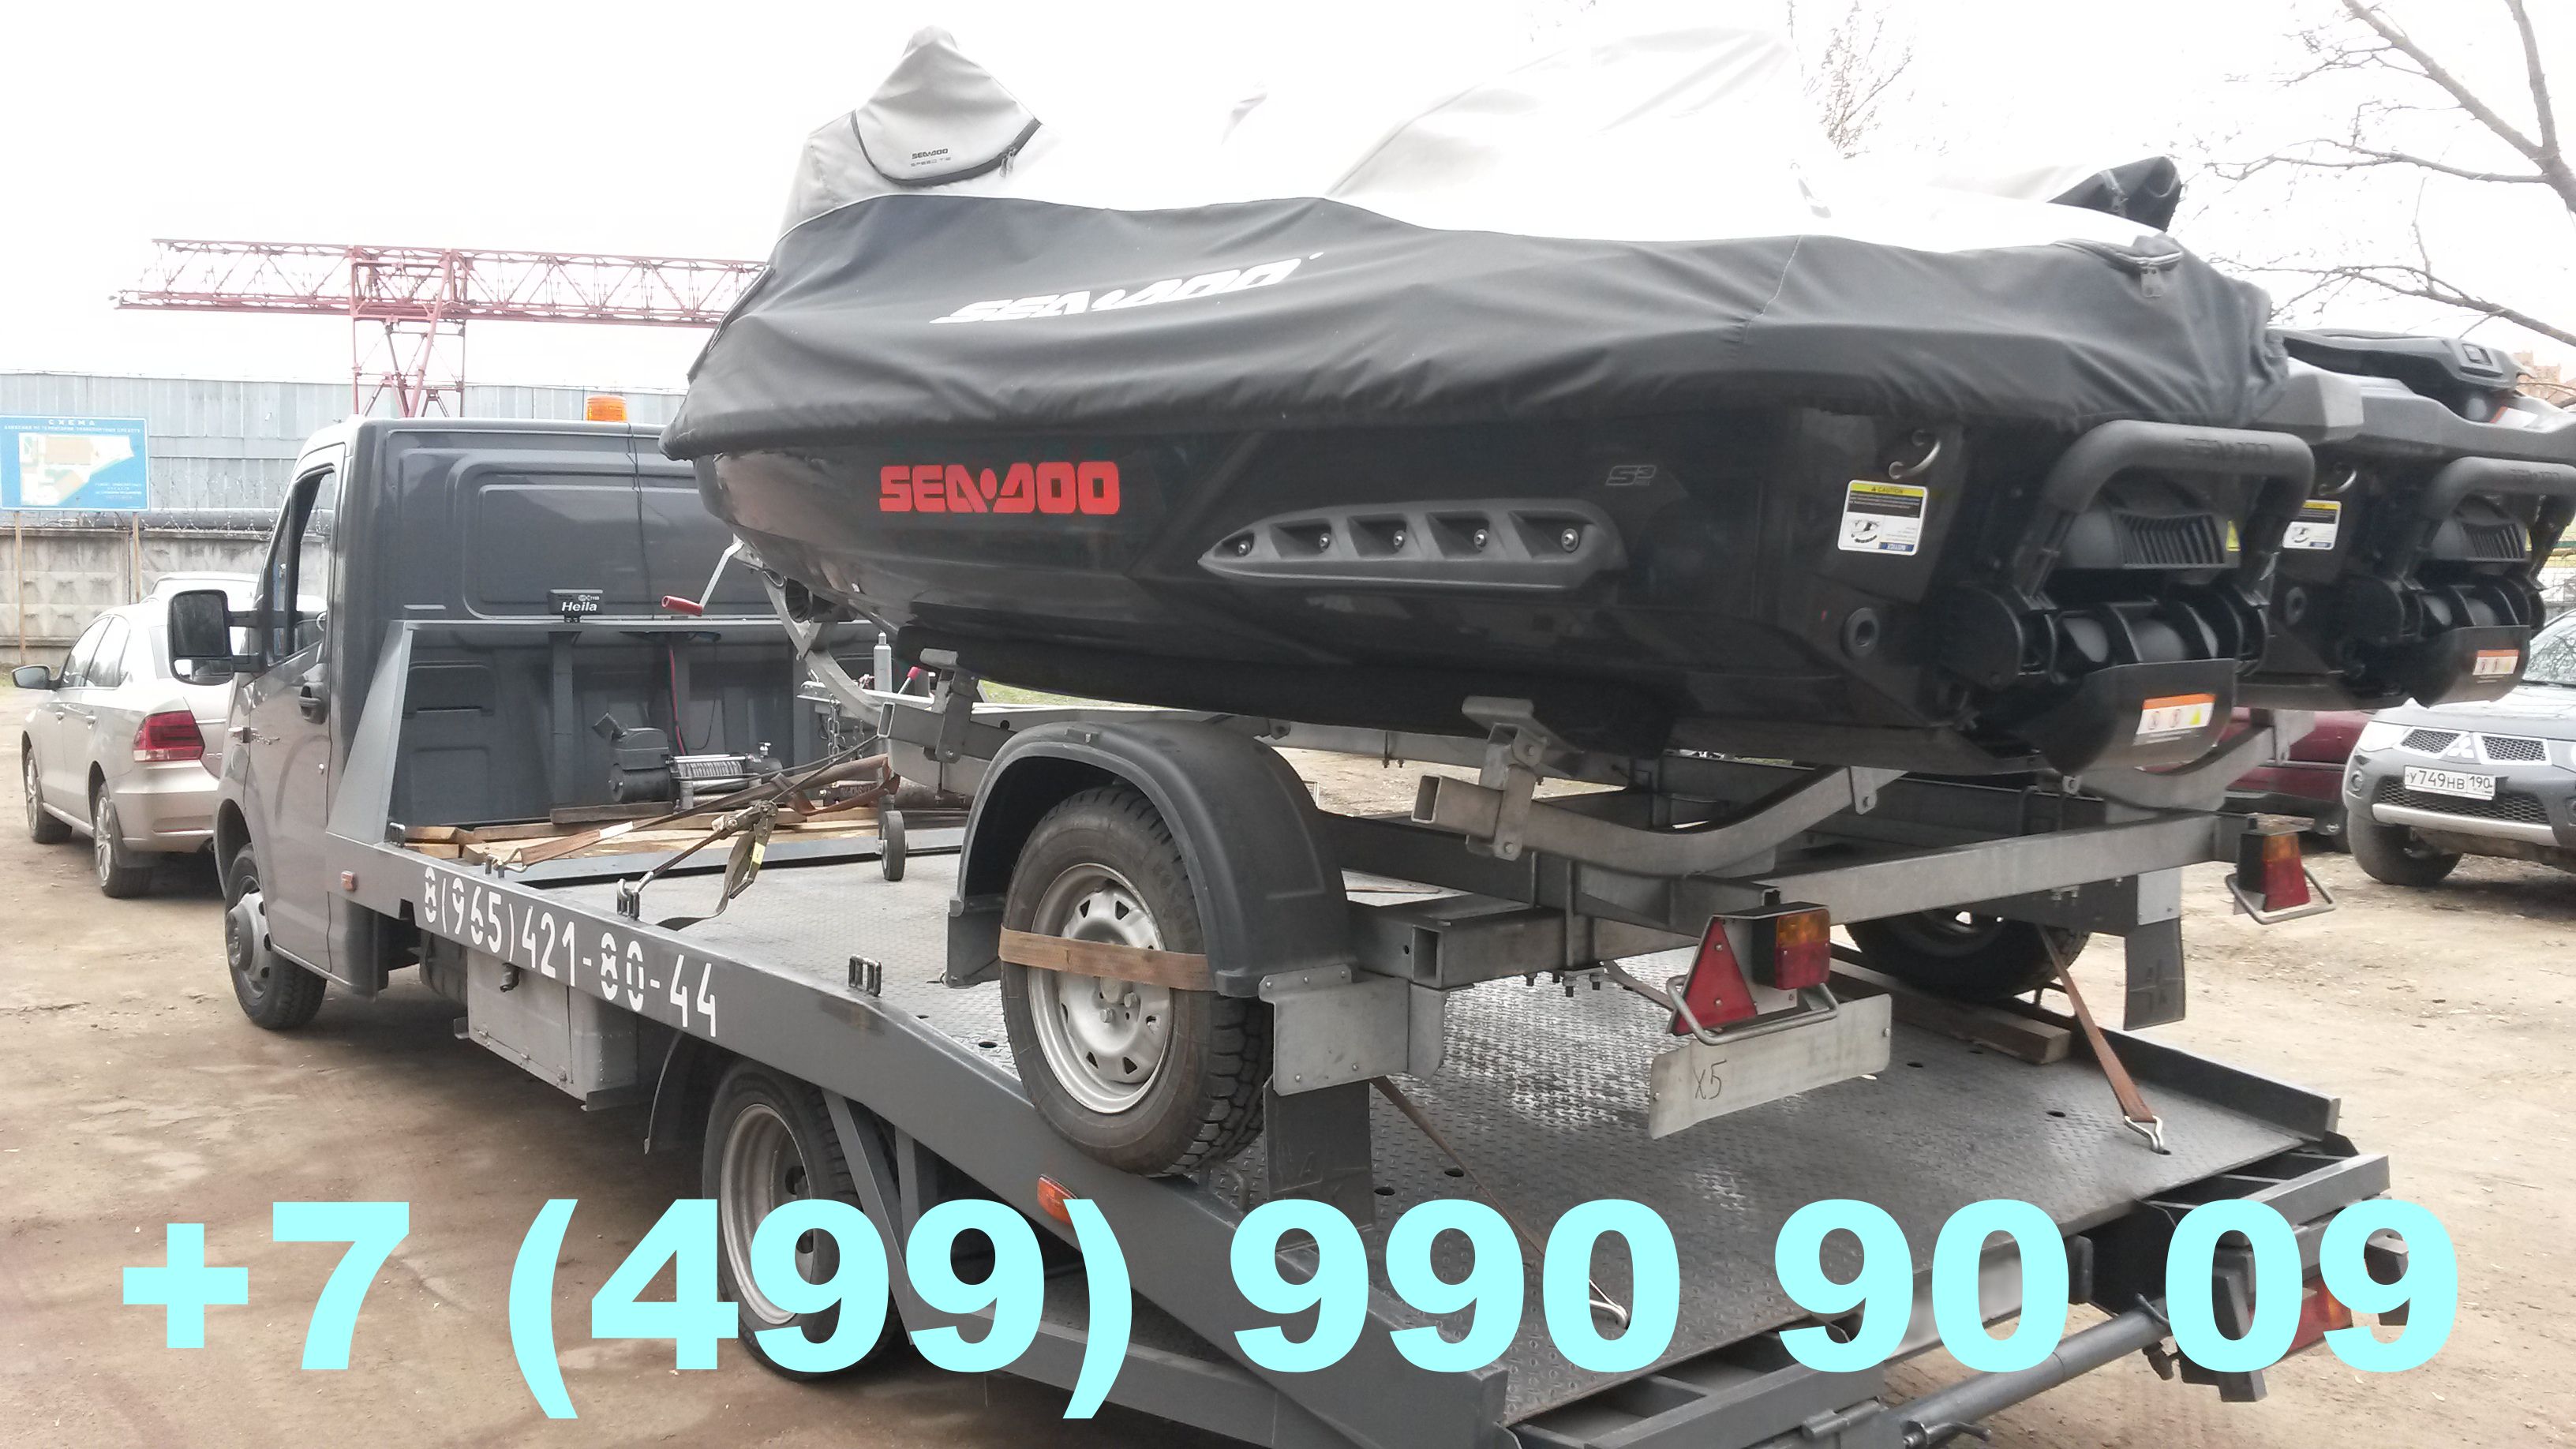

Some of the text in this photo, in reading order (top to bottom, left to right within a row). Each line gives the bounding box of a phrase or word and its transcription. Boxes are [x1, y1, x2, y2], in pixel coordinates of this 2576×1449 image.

[561, 601, 597, 612] Heila
[2469, 775, 2492, 789] 190
[1693, 1058, 1728, 1100] X5
